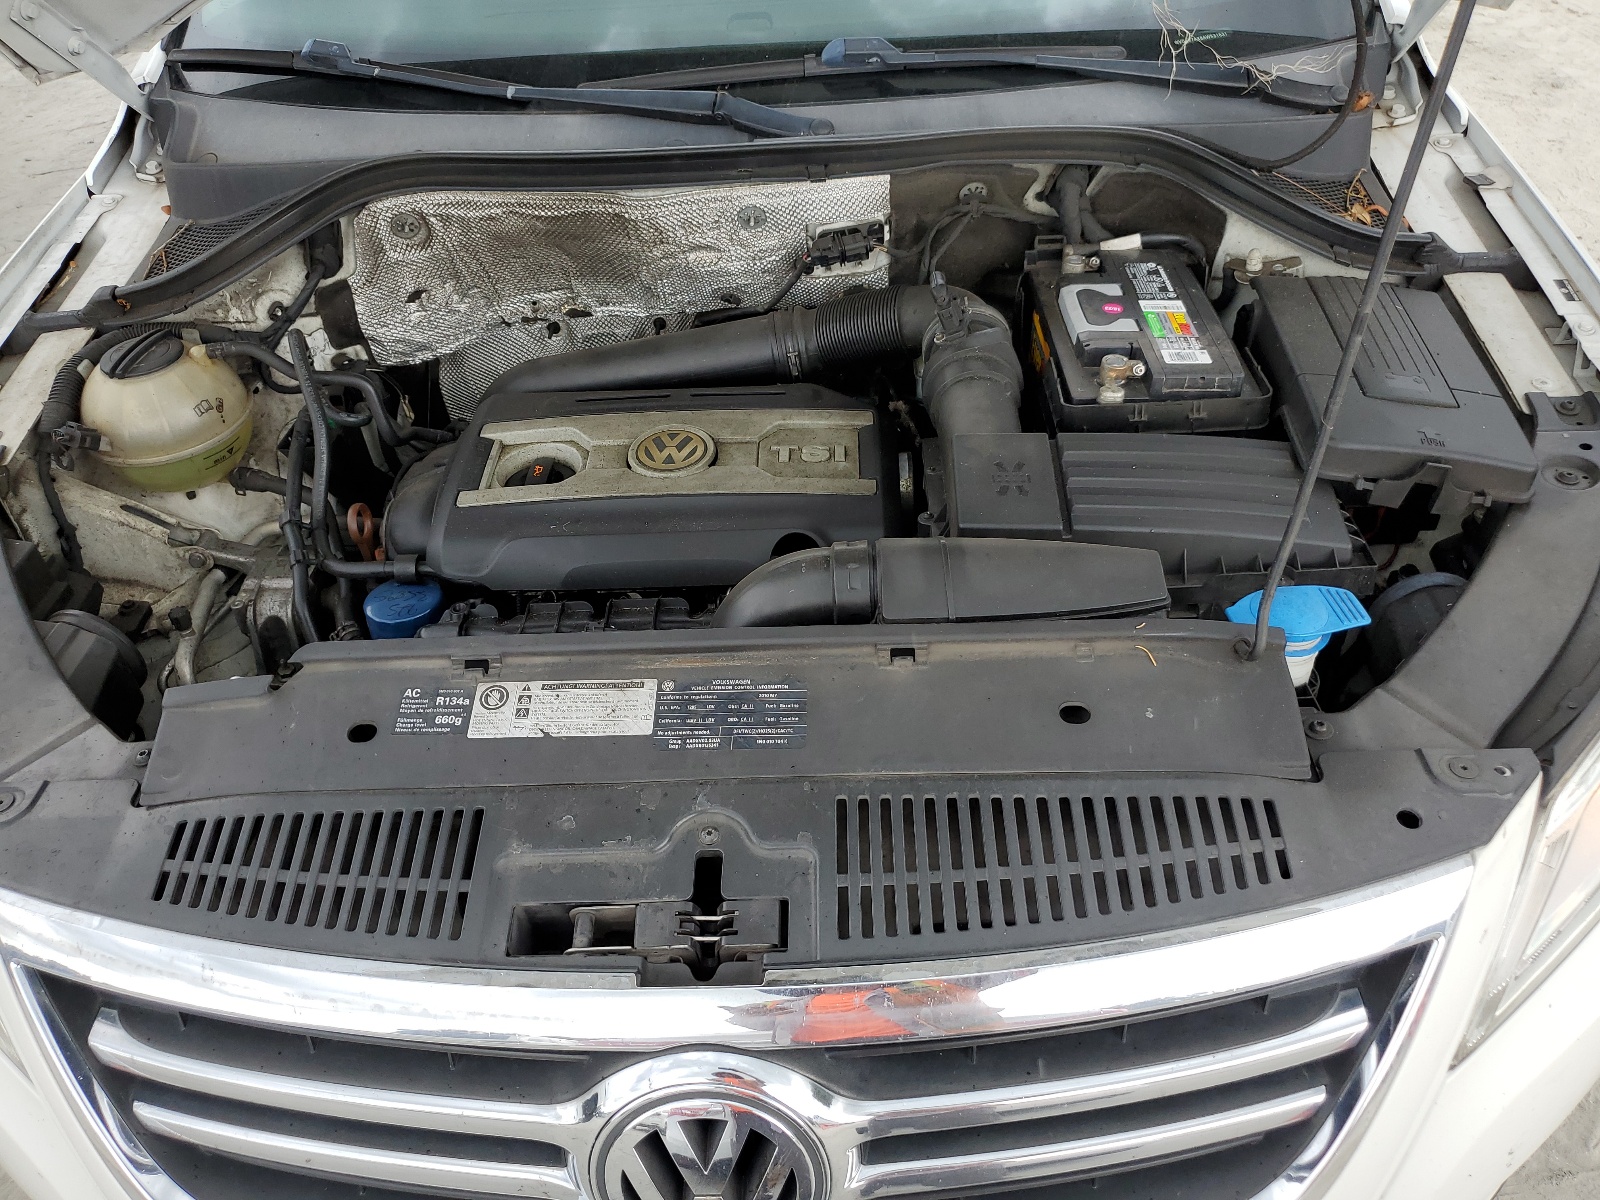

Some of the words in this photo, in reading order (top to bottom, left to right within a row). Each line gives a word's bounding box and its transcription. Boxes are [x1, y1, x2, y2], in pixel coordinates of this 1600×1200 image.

[770, 444, 847, 464] TSI
[403, 688, 421, 698] AC
[436, 696, 470, 706] R134a
[434, 715, 462, 726] 660g
